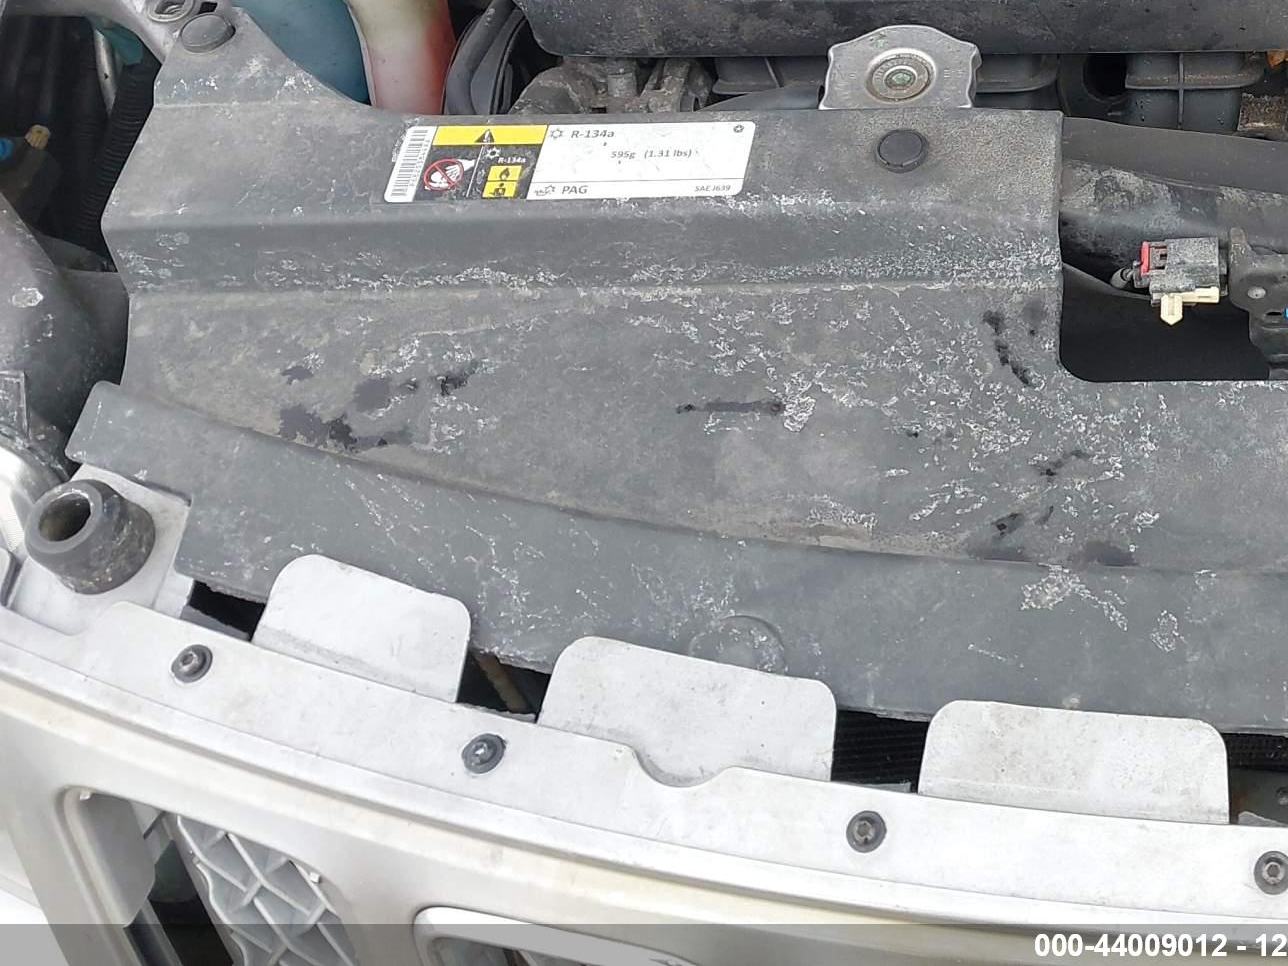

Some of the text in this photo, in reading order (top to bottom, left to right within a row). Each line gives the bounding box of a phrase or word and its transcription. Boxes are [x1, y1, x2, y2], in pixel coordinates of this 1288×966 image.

[570, 129, 615, 139] R-134a
[611, 148, 693, 160] 595g (1.31 lbs)
[497, 157, 527, 165] R-134a
[561, 185, 589, 195] PAG
[694, 185, 711, 193] SAE
